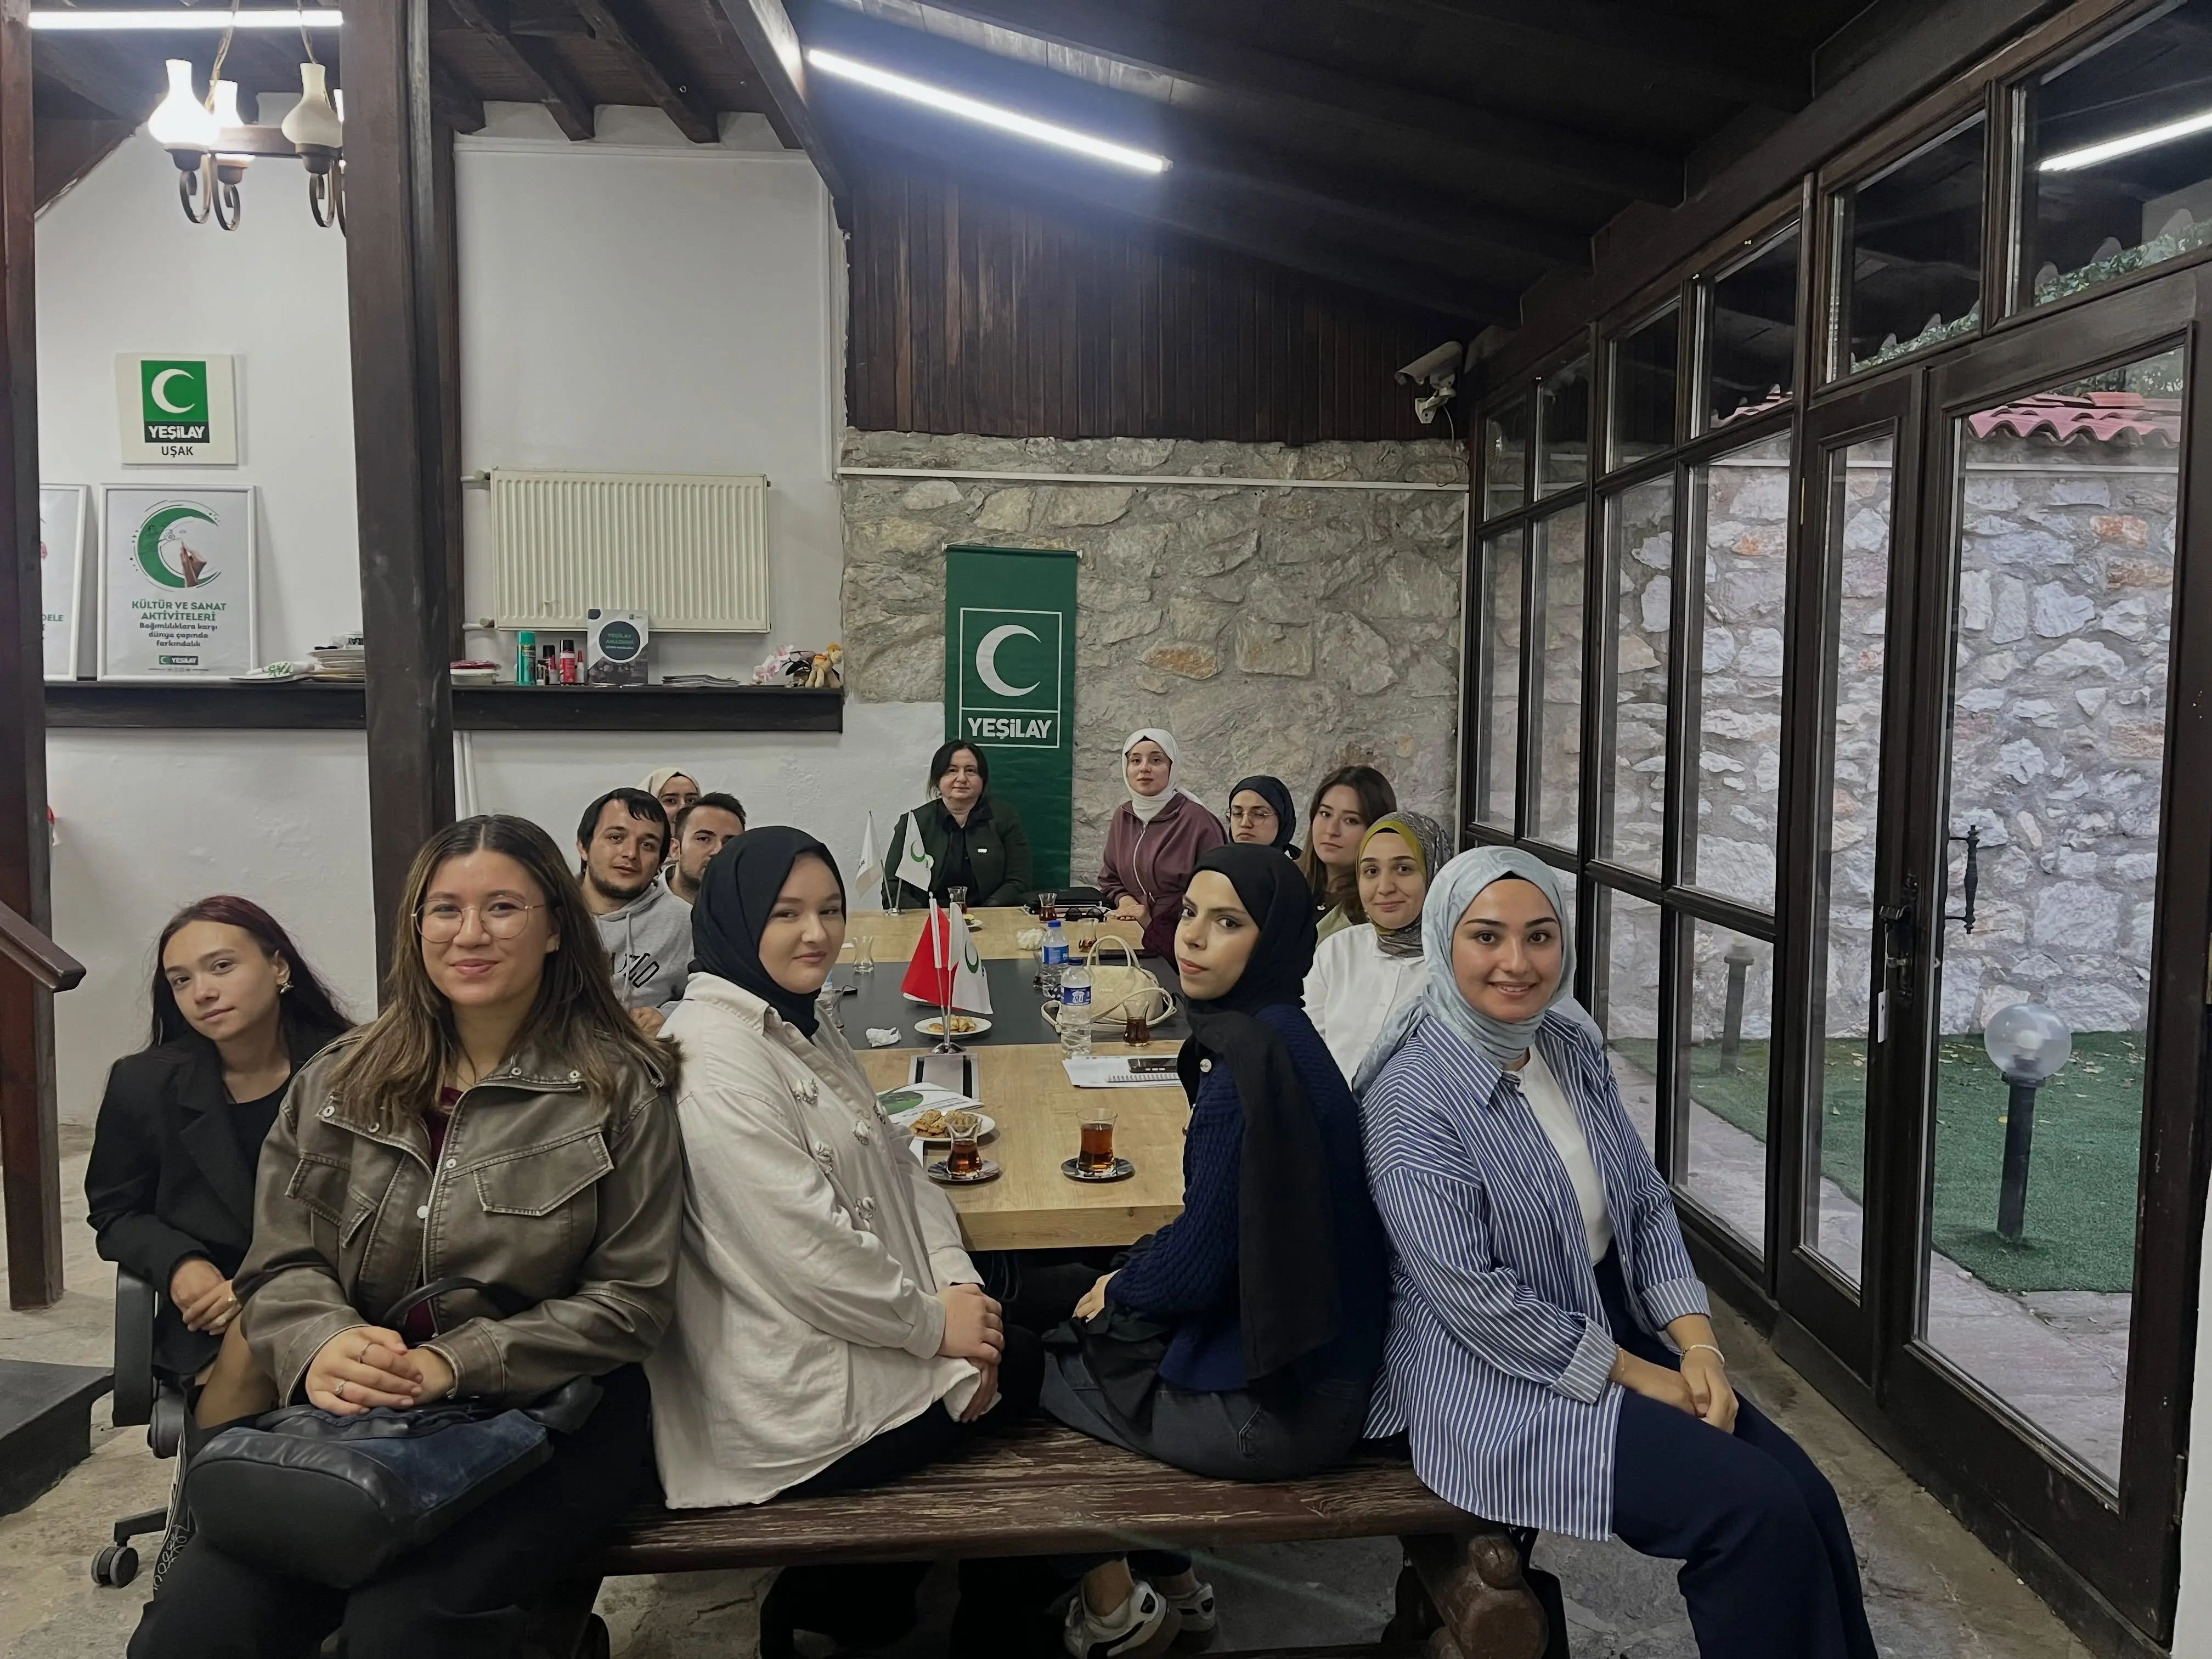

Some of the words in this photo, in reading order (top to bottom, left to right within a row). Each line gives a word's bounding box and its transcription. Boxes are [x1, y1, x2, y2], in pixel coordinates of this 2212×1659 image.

[161, 446, 194, 458] UŞAK
[132, 599, 172, 610] KÜLTÜR
[174, 601, 188, 610] VE
[190, 602, 227, 611] SANAT
[141, 610, 216, 621] AKTİVİTELERİ
[139, 622, 196, 630] Bağımlılıklara
[198, 623, 218, 631] karşı
[148, 631, 174, 640] dünya
